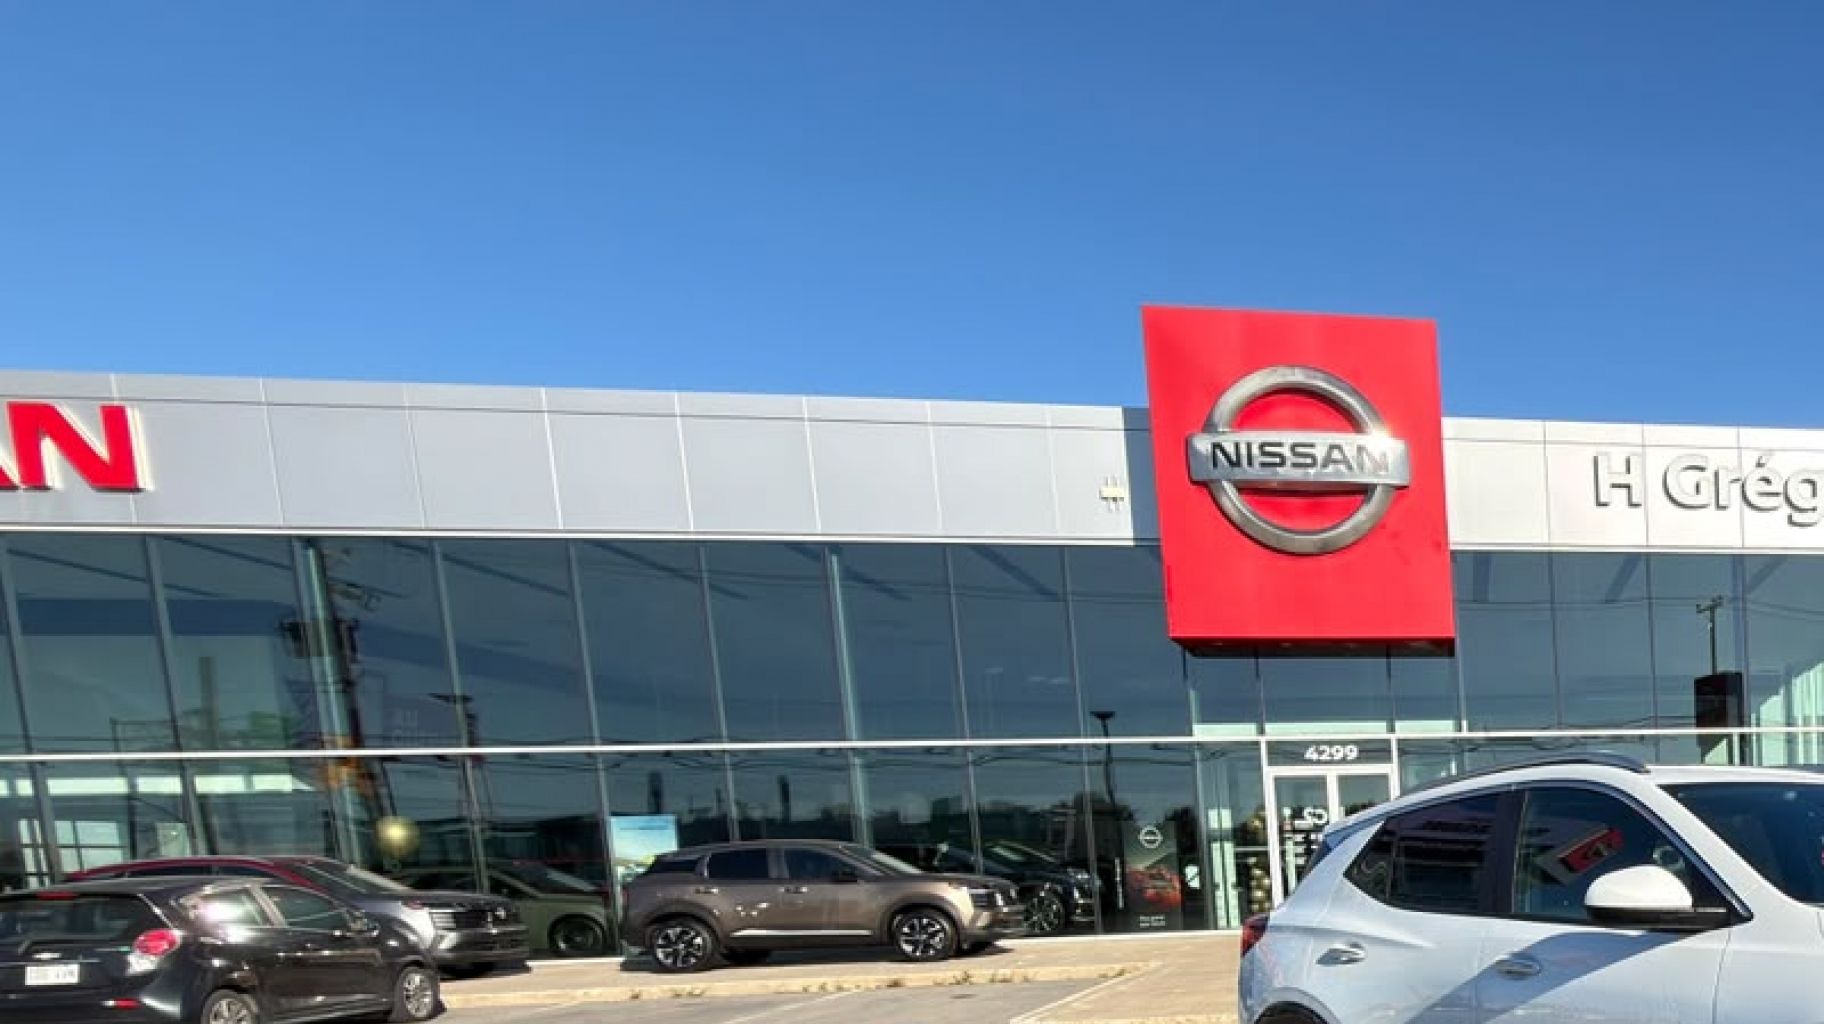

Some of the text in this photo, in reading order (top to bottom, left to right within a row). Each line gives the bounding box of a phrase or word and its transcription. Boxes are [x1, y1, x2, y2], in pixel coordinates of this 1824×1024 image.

[1210, 441, 1390, 474] NISSAN
[1593, 451, 1643, 508] H
[1303, 745, 1359, 761] 4299
